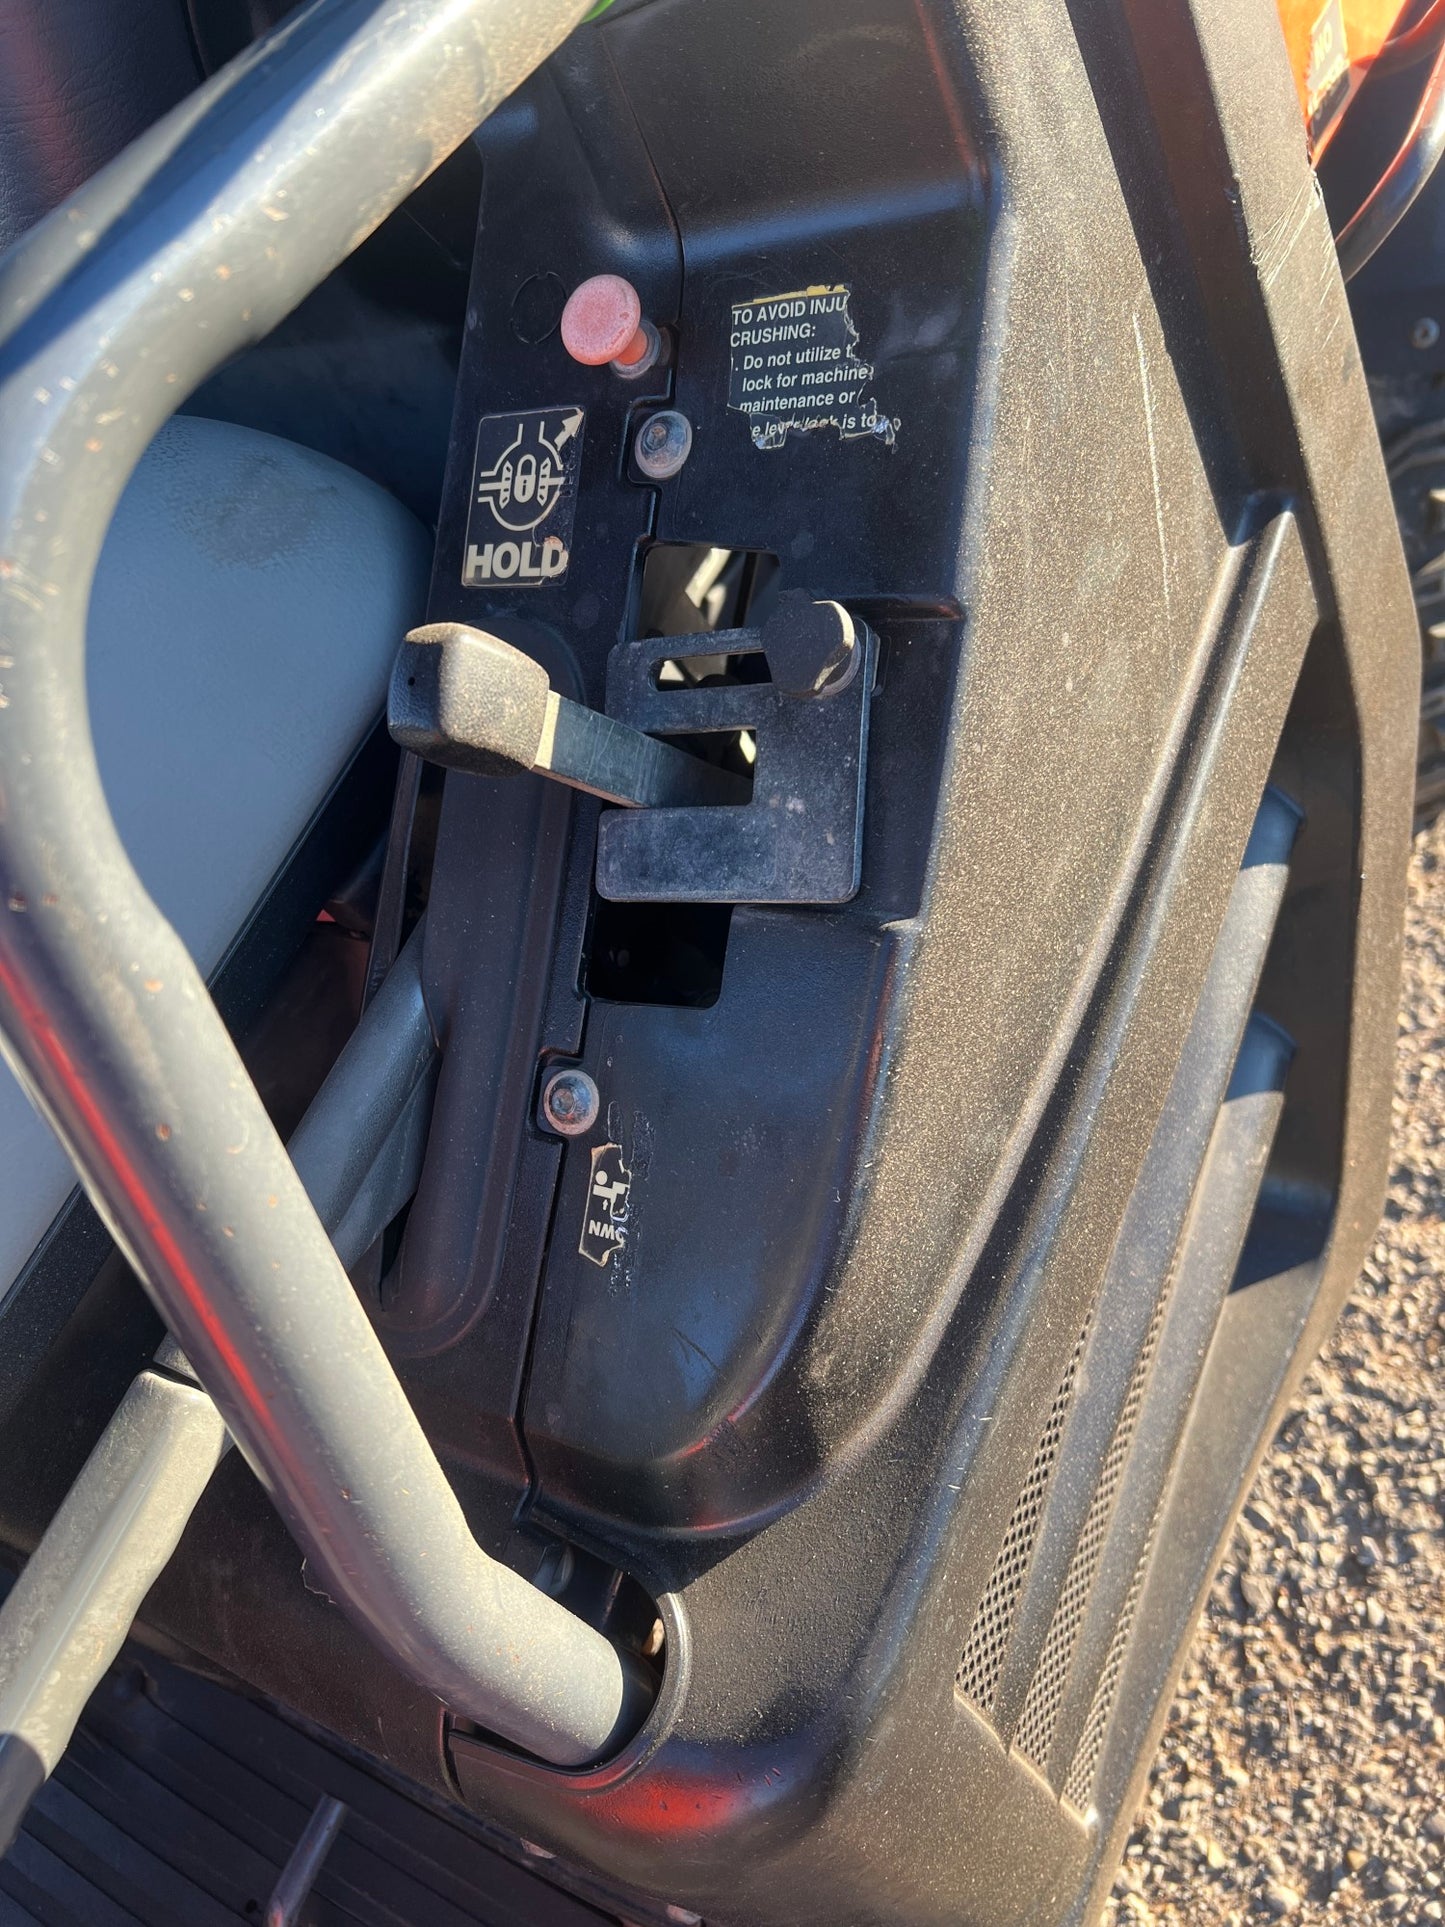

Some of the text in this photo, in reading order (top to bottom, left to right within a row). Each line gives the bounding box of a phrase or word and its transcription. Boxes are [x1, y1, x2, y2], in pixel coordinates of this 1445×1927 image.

[732, 296, 847, 326] TO AVOID INJU
[730, 322, 816, 348] CRUSHING:
[743, 355, 763, 370] Do
[767, 353, 792, 367] not
[795, 347, 841, 364] utilize
[742, 365, 868, 392] lock for machine
[739, 391, 856, 413] maintenance or
[842, 413, 857, 430] is
[465, 538, 569, 579] HOLD
